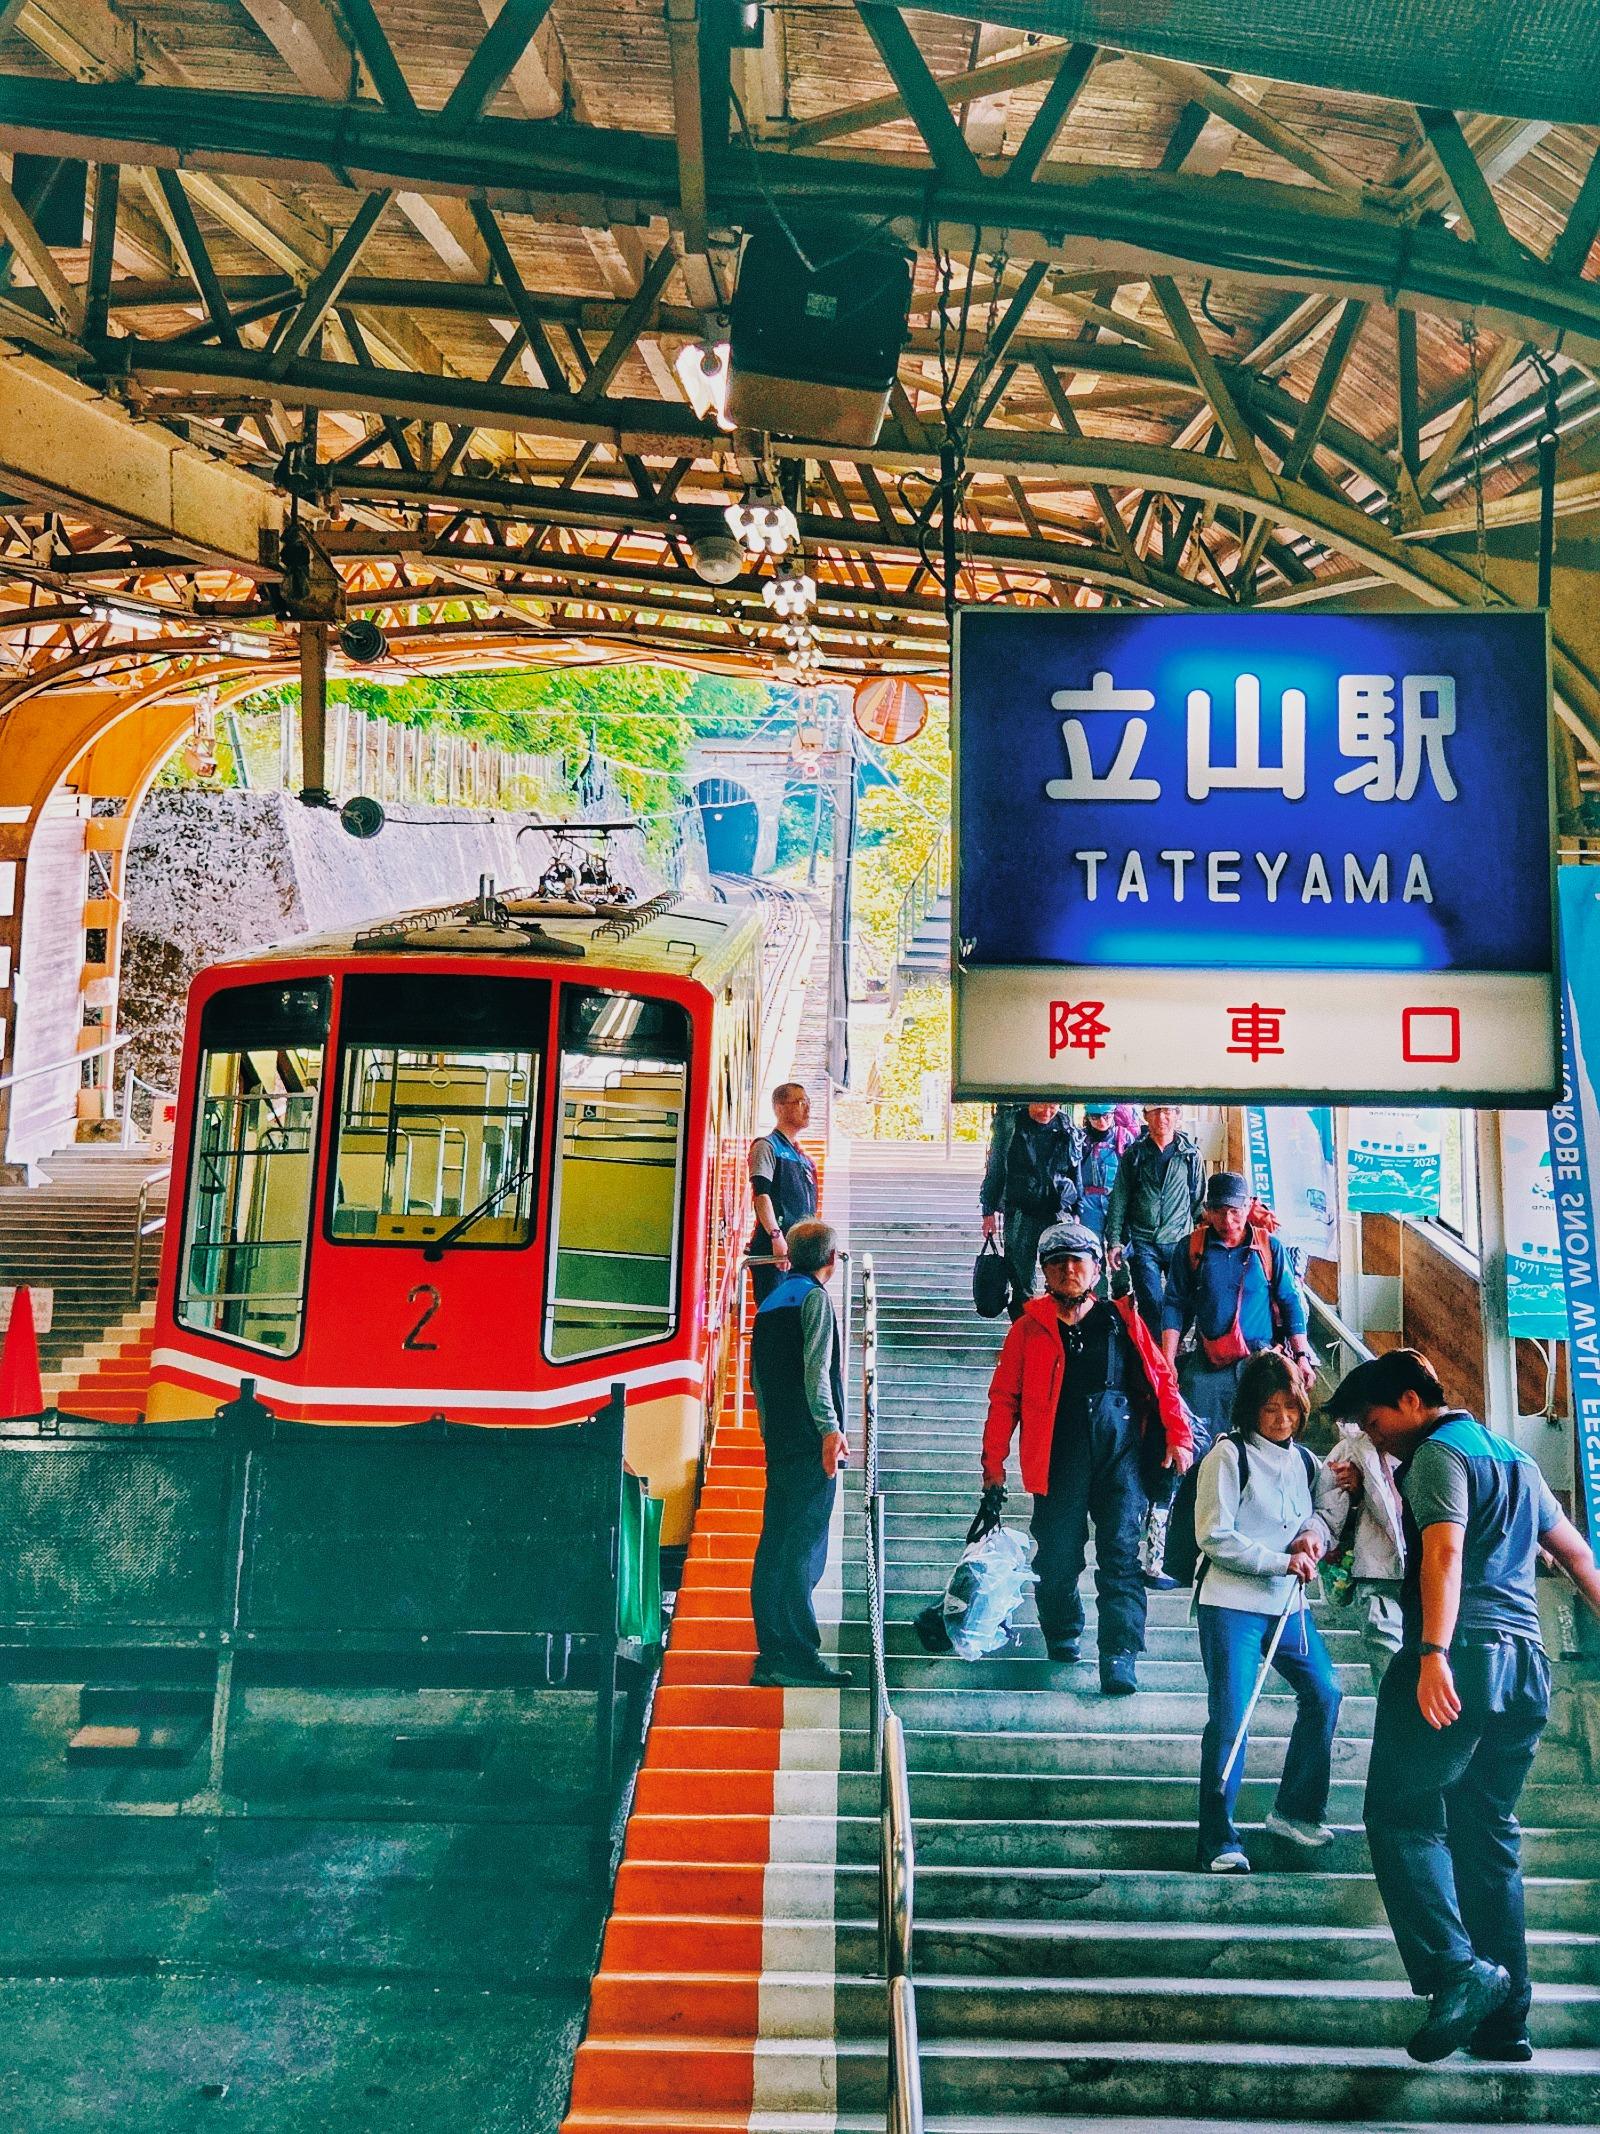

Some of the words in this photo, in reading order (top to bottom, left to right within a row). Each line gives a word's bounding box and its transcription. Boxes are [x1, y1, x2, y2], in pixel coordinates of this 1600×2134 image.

[1045, 671, 1458, 802] 立山駅
[1075, 850, 1433, 904] TATEYAMA
[1049, 1001, 1461, 1064] 降車口
[1354, 1153, 1374, 1165] 1971
[1514, 1260, 1540, 1276] 1971
[402, 1284, 441, 1350] 2
